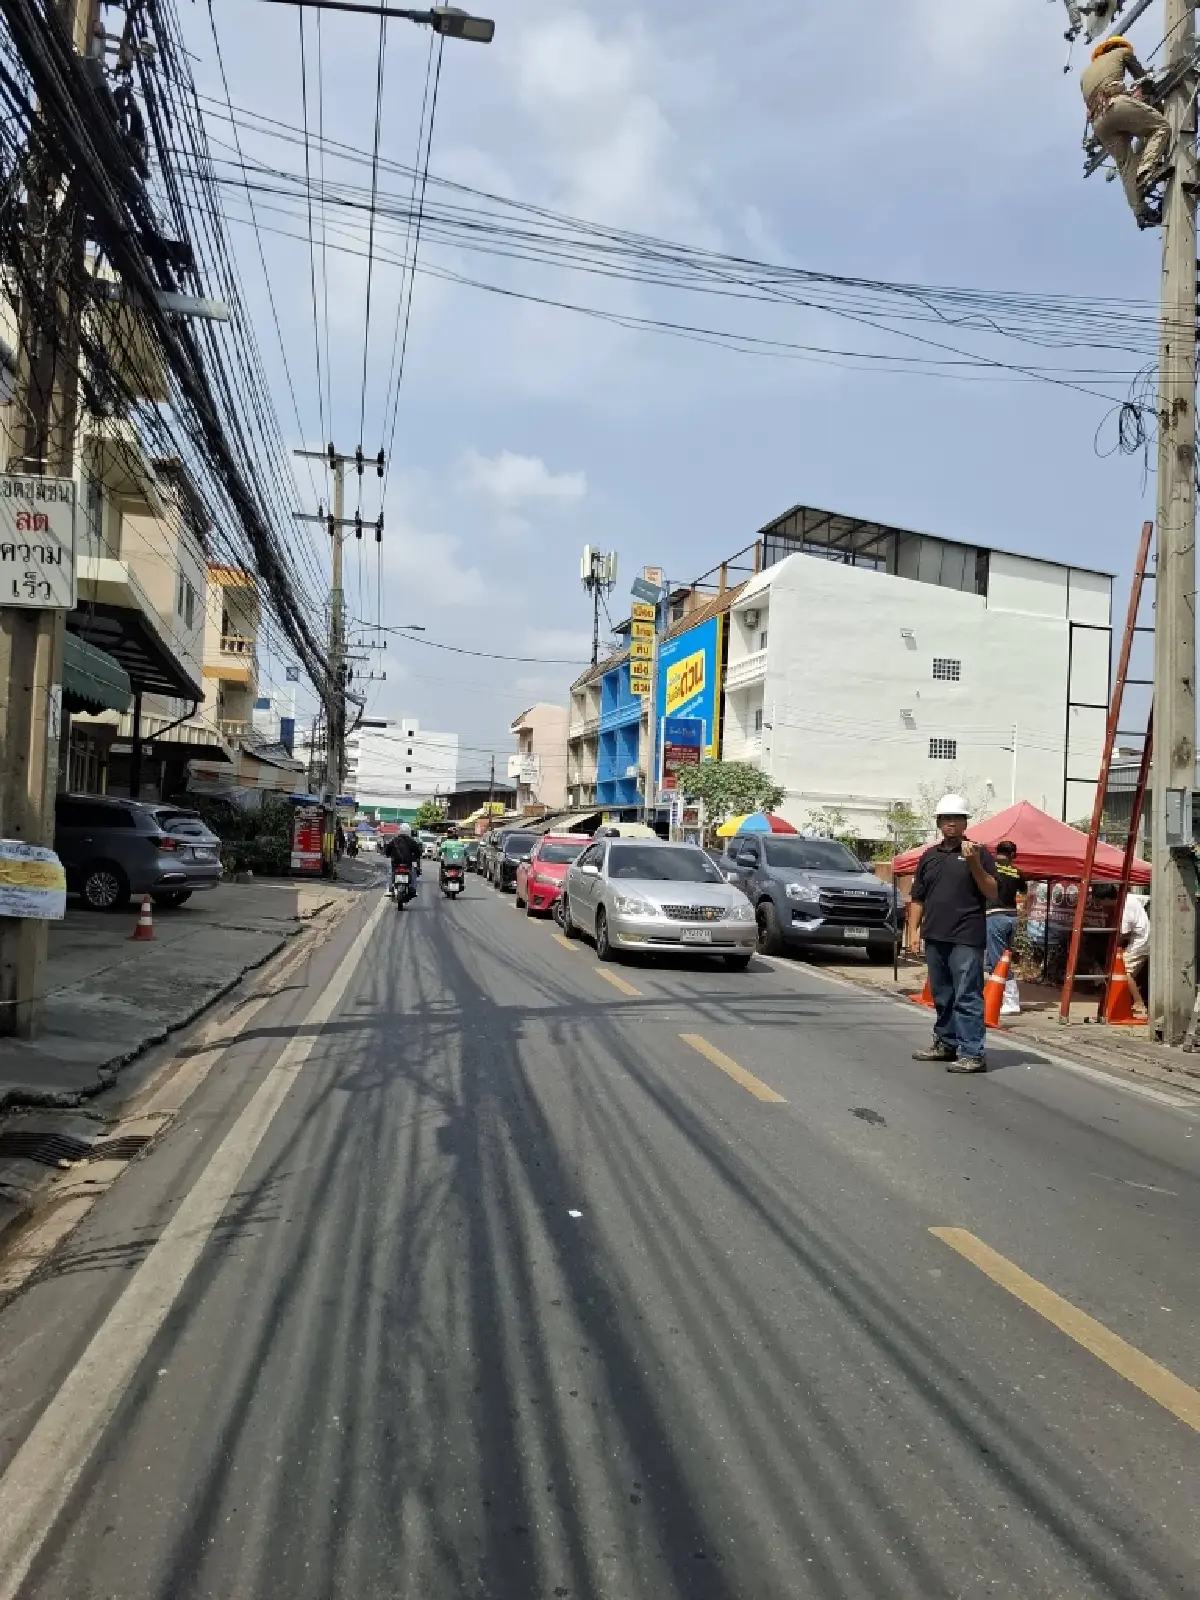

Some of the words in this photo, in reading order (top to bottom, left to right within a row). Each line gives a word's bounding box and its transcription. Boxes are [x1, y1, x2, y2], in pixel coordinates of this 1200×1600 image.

[15, 511, 48, 532] ลด
[1, 543, 61, 565] ความ
[12, 571, 51, 600] เร็ว
